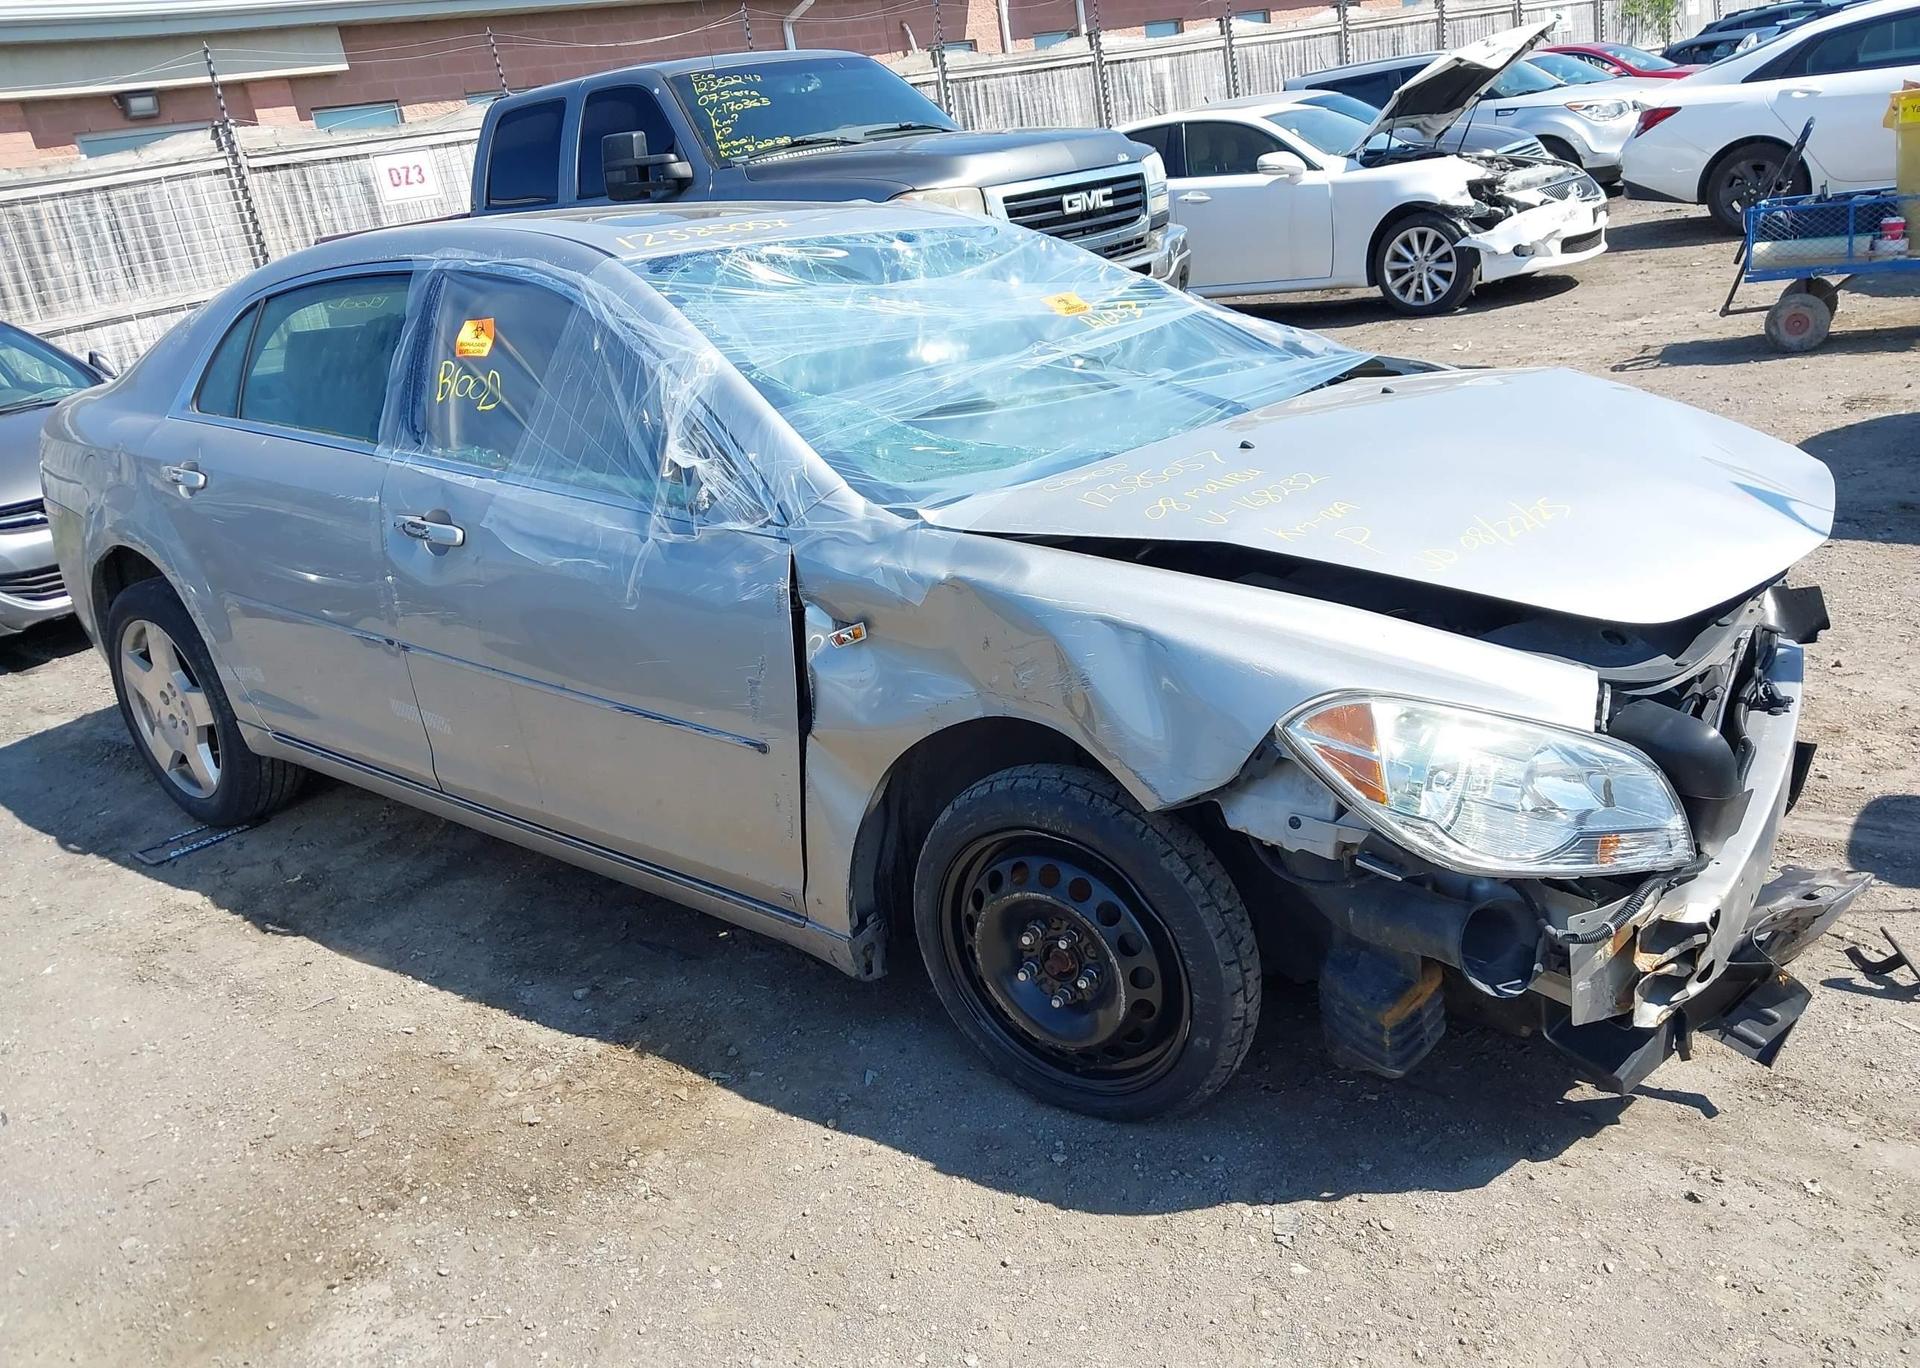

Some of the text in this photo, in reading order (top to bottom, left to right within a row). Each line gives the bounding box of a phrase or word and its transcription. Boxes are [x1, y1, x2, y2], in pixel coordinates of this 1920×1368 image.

[1062, 187, 1114, 215] GMC
[1077, 449, 1227, 509] 12385057
[1144, 496, 1192, 521] 08
